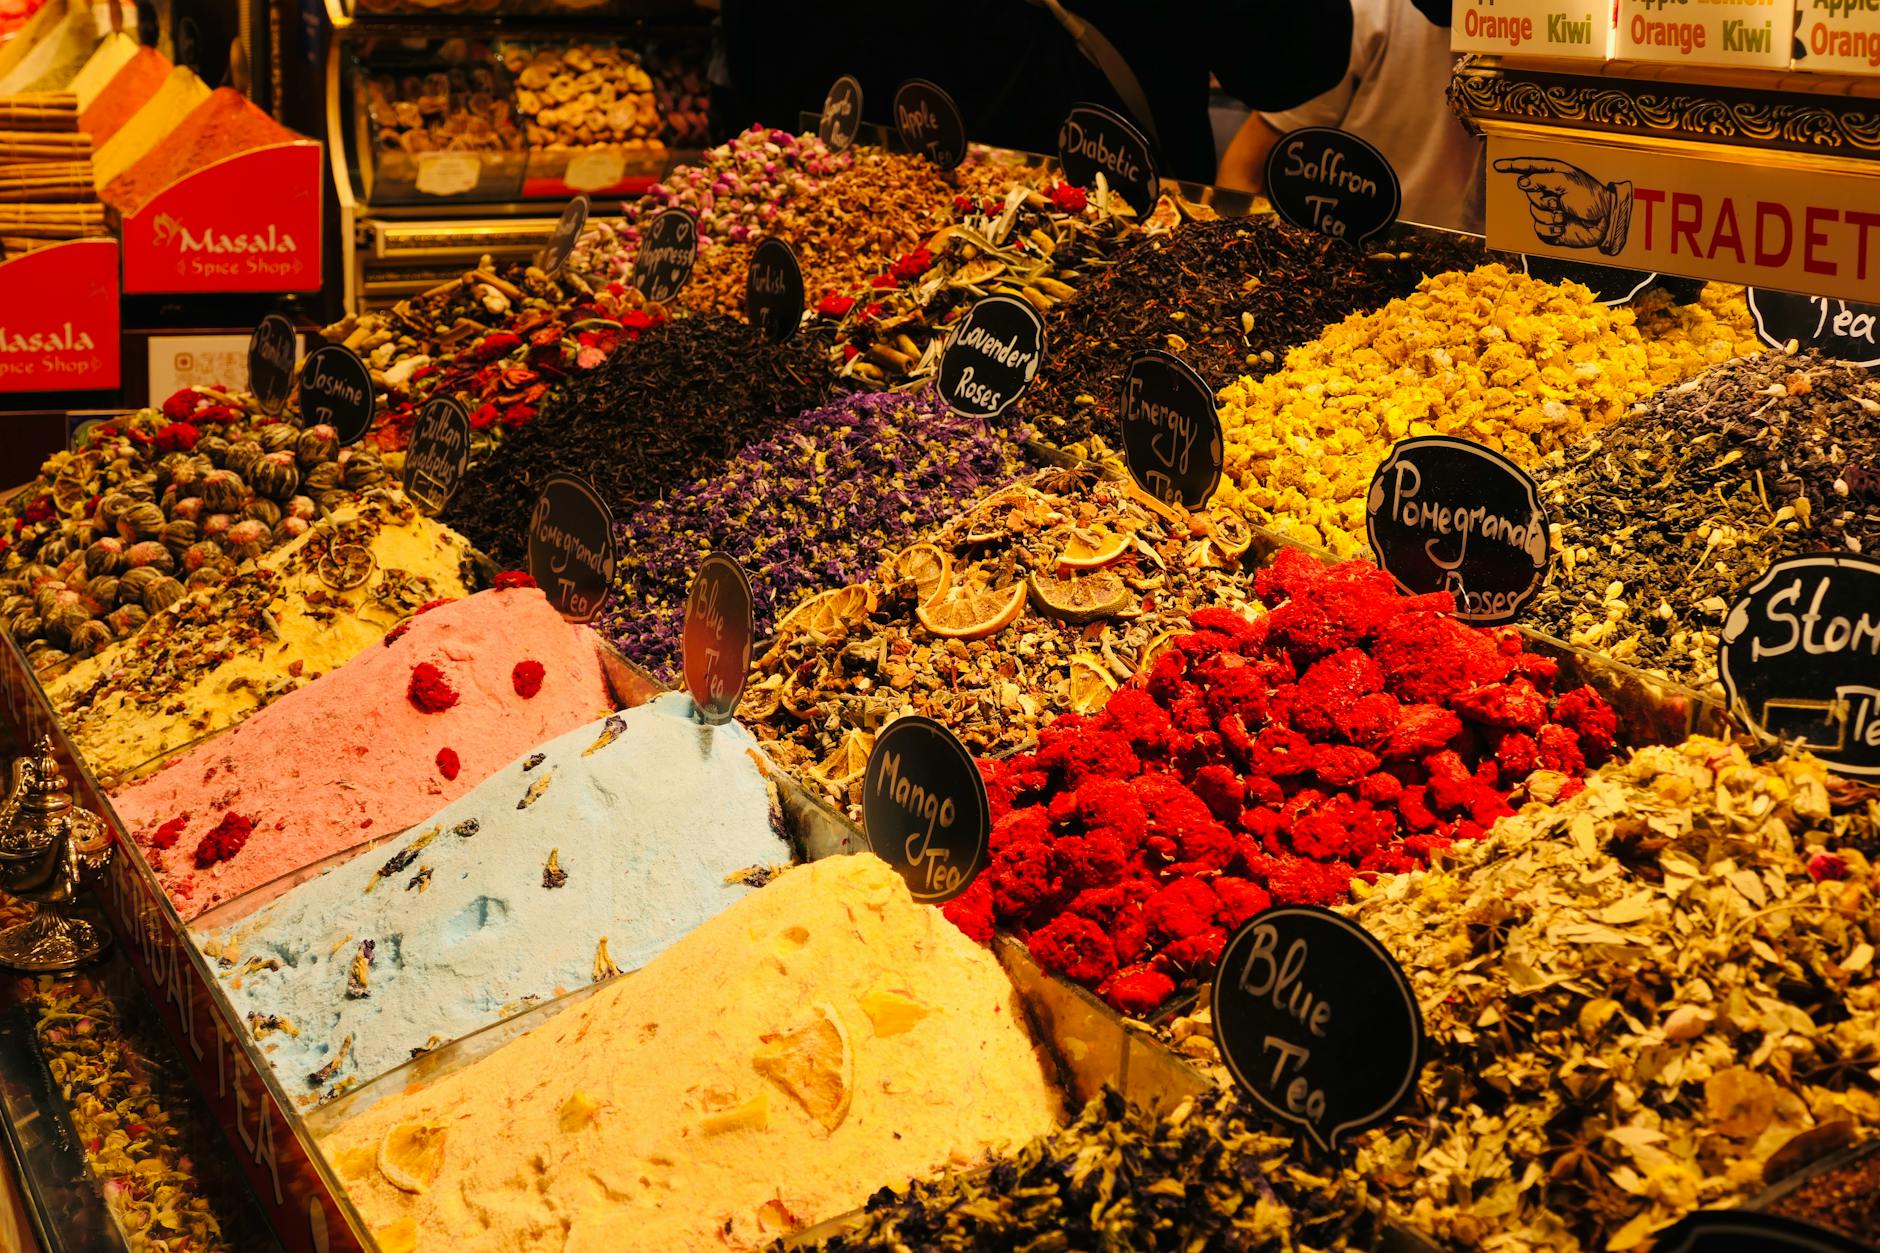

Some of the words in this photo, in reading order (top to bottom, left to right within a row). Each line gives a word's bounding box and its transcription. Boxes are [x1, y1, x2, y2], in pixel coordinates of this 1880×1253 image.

[1464, 8, 1533, 47] Orange
[1547, 13, 1592, 45] Kiwi
[1630, 14, 1706, 55] Orange
[1722, 20, 1772, 53] Kiwi
[899, 99, 939, 139] Apple
[1067, 121, 1139, 182] Diabetic
[1284, 141, 1377, 198] Saffron
[180, 223, 297, 253] Masala
[1305, 195, 1346, 237] Tea
[1634, 188, 1880, 281] TRADET
[191, 256, 239, 277] Spice
[246, 255, 291, 276] Shop
[751, 263, 786, 295] Turkish
[957, 313, 1032, 368] Lavender
[41, 354, 89, 375] Shop
[954, 366, 1001, 411] Roses
[1128, 377, 1198, 475] Energy
[1146, 470, 1184, 504] Tea
[557, 577, 588, 615] Tea
[696, 577, 725, 641] Blue
[705, 648, 724, 700] Tea
[877, 750, 956, 867] Mango
[925, 848, 961, 892] Tea
[1239, 923, 1332, 1037] Blue
[1263, 1035, 1327, 1125] Tea
[209, 1003, 285, 1206] TEA
